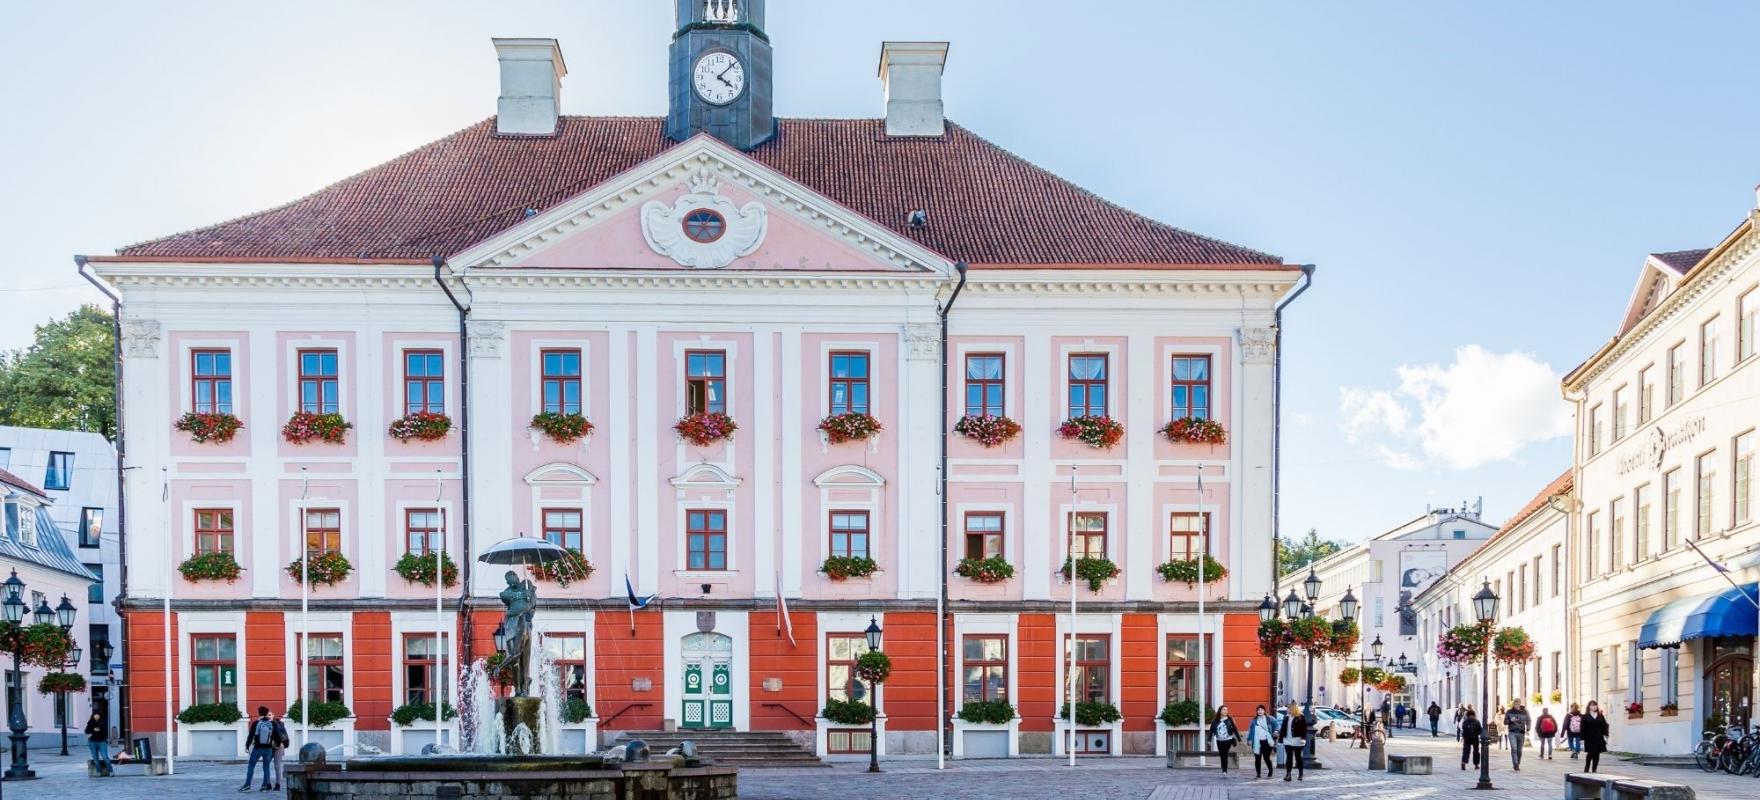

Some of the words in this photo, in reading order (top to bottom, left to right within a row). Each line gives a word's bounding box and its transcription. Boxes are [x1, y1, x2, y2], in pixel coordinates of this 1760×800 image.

[716, 55, 724, 63] 12
[706, 89, 712, 97] 7
[728, 89, 734, 97] 5
